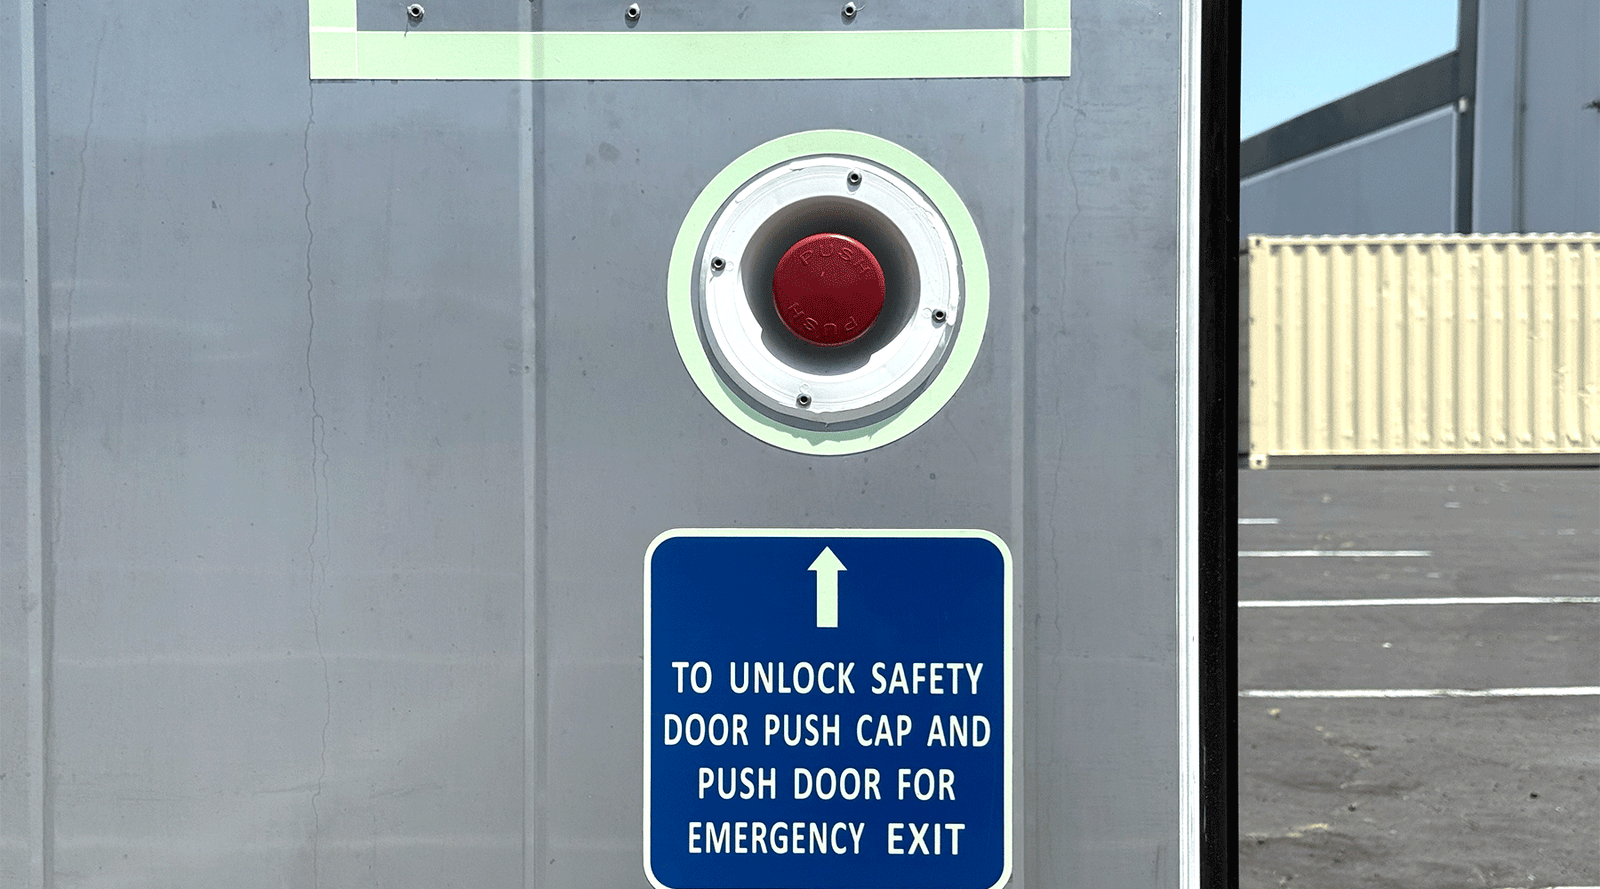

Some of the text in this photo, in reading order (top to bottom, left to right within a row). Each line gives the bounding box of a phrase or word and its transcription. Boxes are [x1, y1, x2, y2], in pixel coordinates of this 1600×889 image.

[800, 243, 870, 274] PUSH
[788, 302, 858, 335] PUSH
[672, 662, 984, 695] TO UNLOCK SAFETY
[665, 714, 991, 747] DOOR PUSH CAP AND
[699, 768, 956, 800] PUSH DOOR FOR
[689, 822, 966, 855] EMERGENCY EXIT
